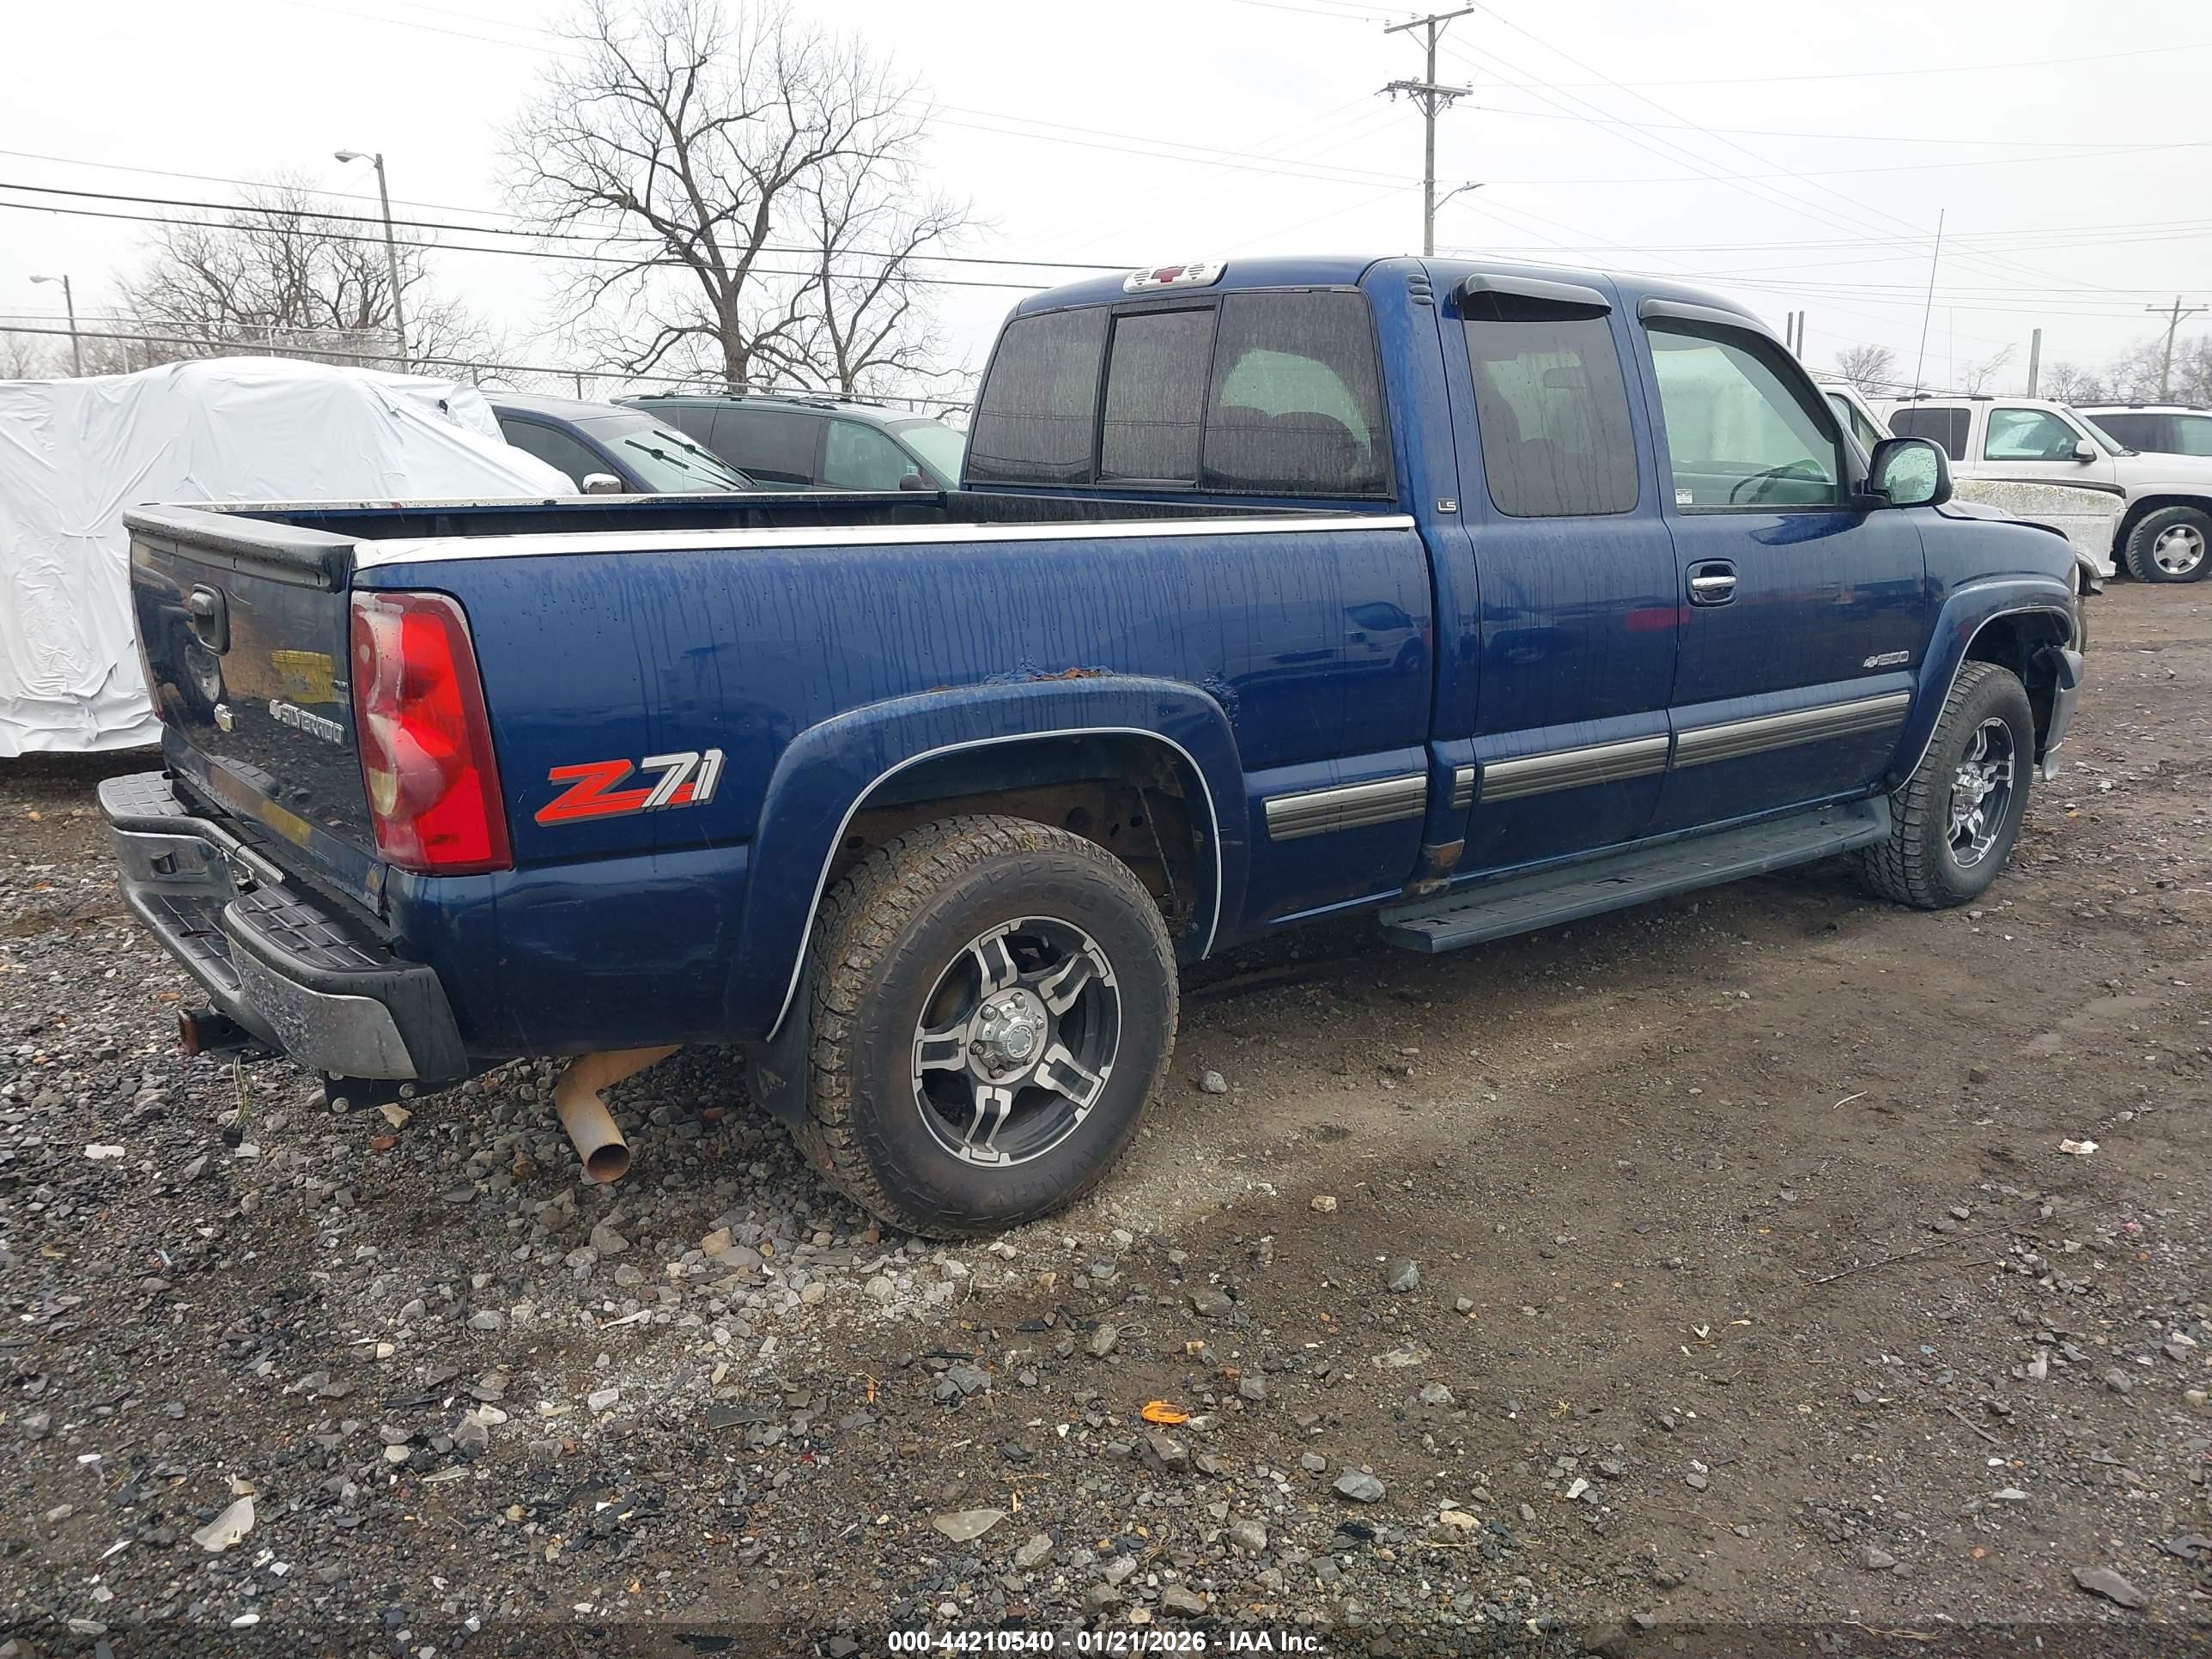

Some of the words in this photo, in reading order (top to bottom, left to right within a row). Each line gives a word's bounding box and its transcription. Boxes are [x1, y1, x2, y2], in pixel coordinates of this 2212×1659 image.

[1437, 501, 1456, 511] LS
[1877, 650, 1909, 666] 1500
[280, 702, 344, 746] SILVERADO
[534, 748, 725, 827] Z71
